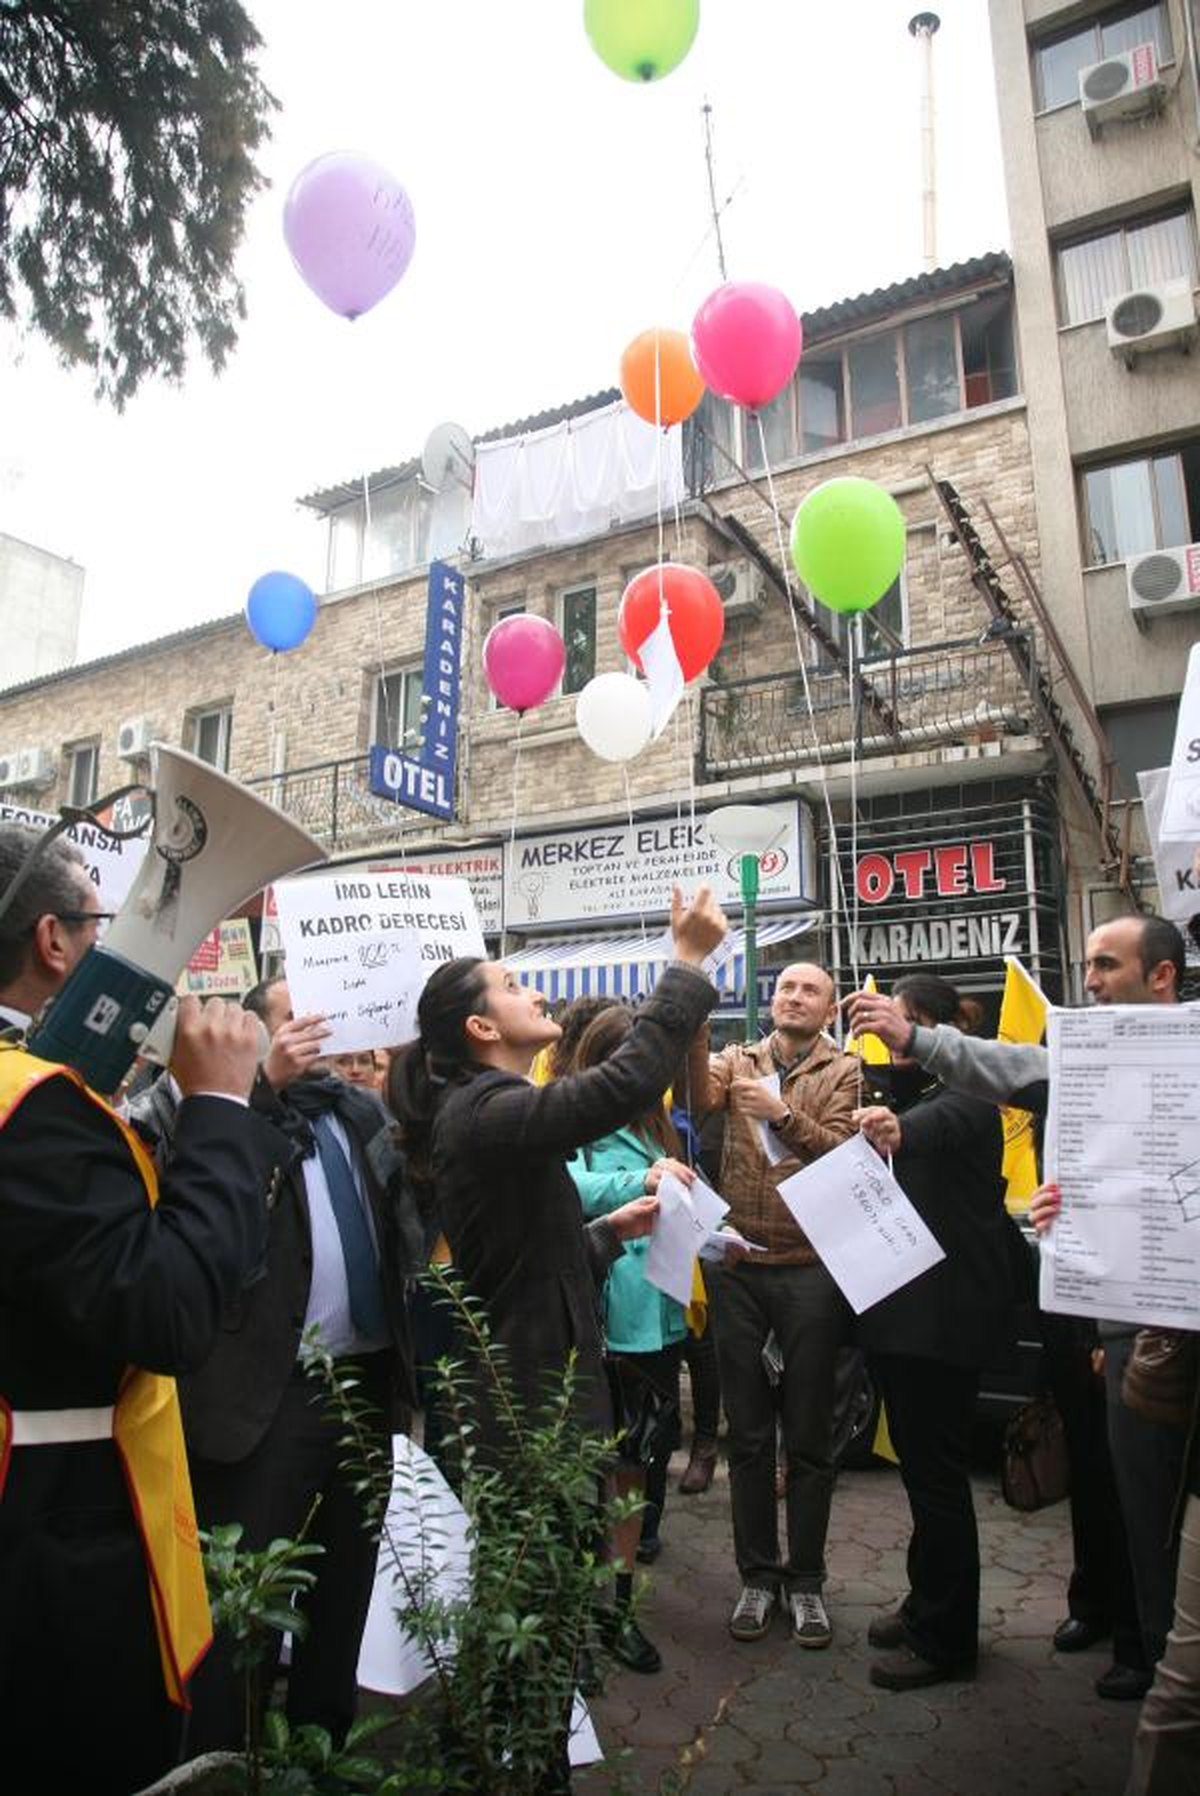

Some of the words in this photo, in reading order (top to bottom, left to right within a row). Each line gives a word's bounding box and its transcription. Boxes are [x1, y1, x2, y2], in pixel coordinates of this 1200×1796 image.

[383, 753, 451, 809] OTEL
[521, 835, 624, 869] MERKEZ
[637, 824, 704, 853] ELEK
[573, 862, 621, 876] TOPTAN
[856, 842, 1006, 903] OTEL
[300, 913, 372, 938] KADRO
[379, 911, 467, 931] DERECESİ
